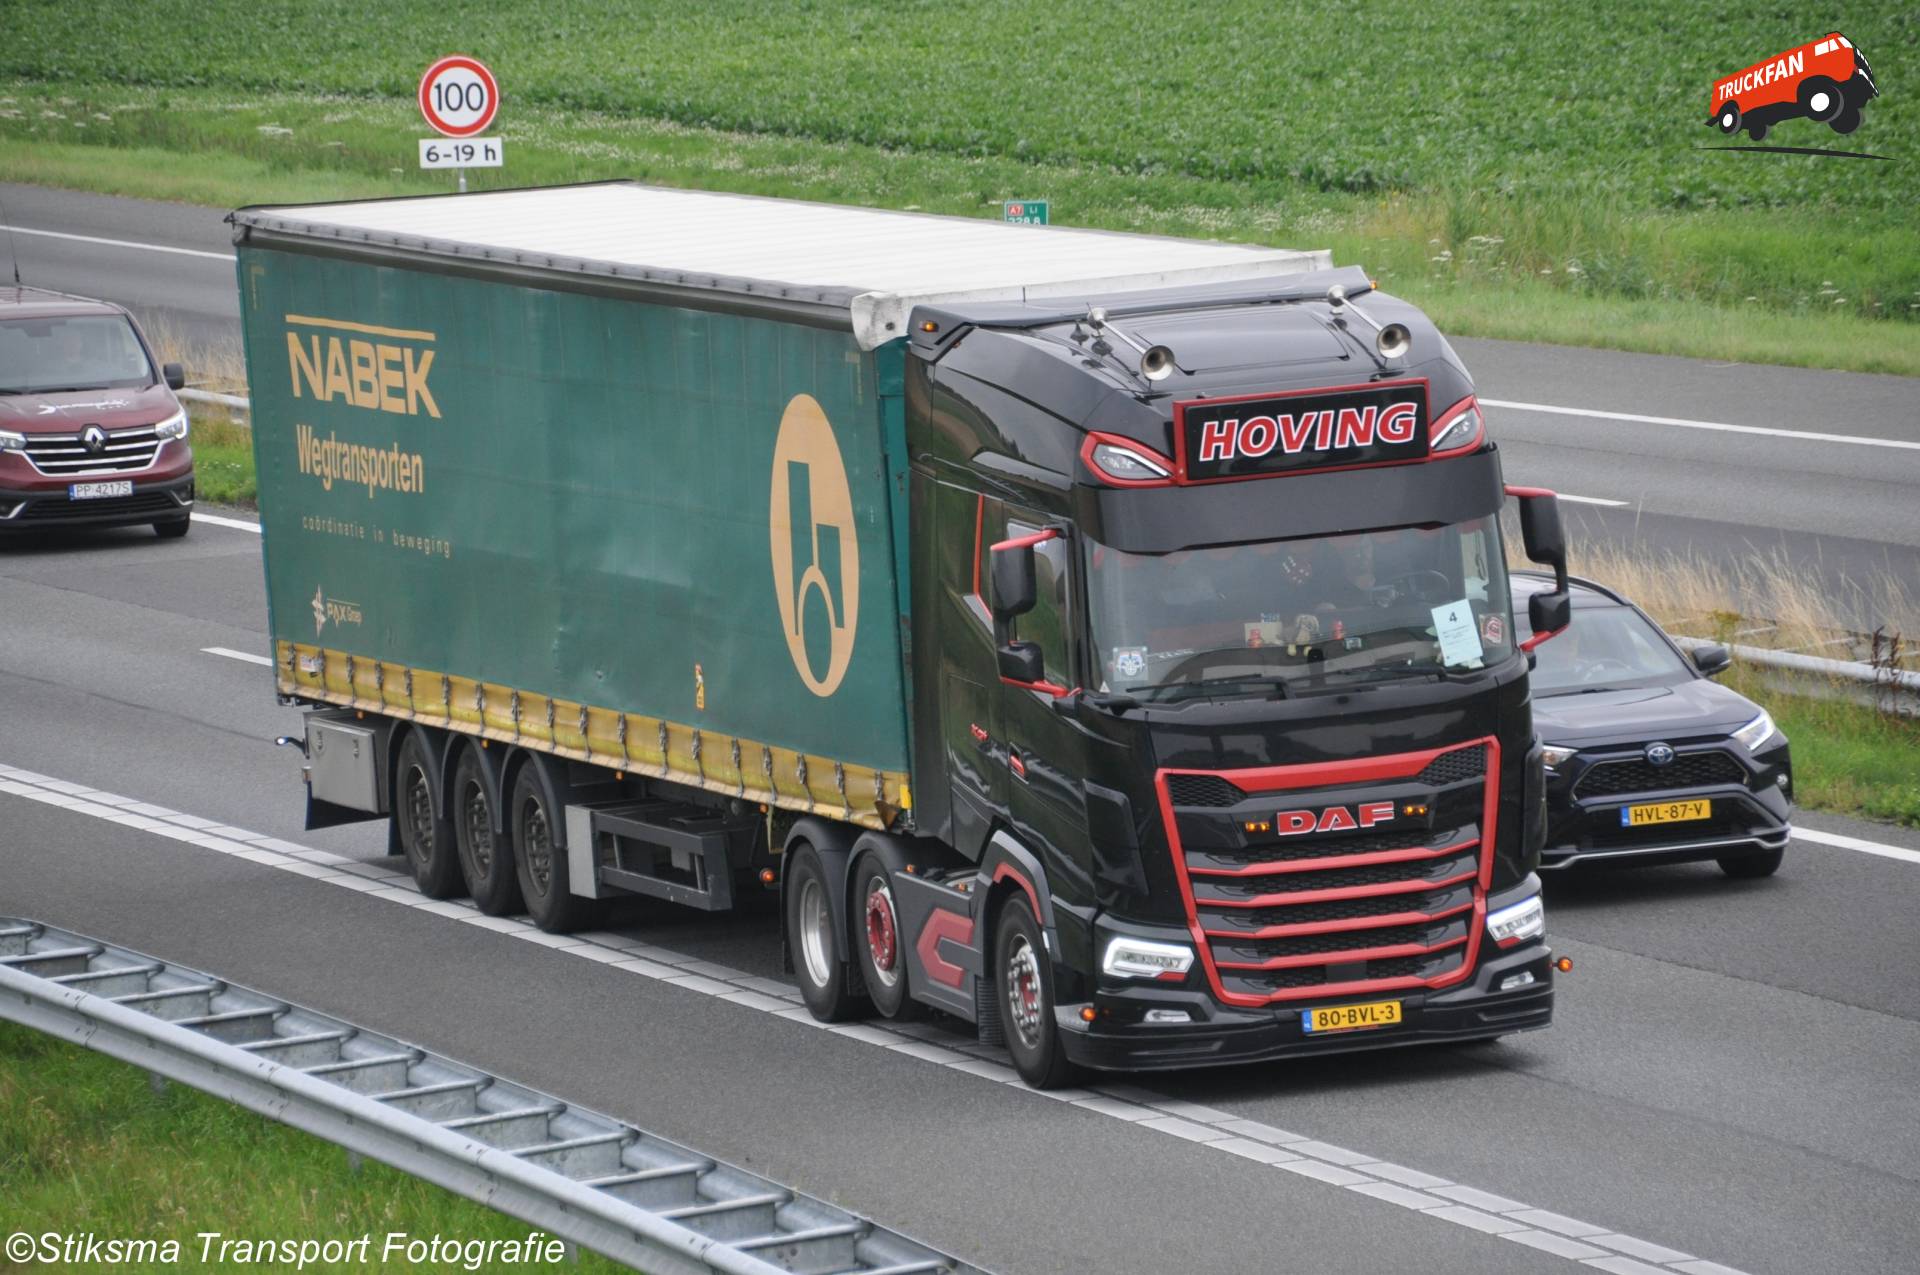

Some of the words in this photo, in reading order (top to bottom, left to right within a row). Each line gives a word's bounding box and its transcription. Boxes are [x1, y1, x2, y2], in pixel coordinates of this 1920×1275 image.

[434, 82, 484, 112] 100
[426, 144, 475, 162] 6-19
[484, 143, 497, 161] h
[286, 332, 442, 418] NABEK
[1199, 402, 1418, 462] HOVING
[296, 424, 424, 499] Wegtransporten
[373, 525, 384, 543] in
[392, 528, 450, 559] beweging
[1449, 611, 1458, 623] 4
[1276, 801, 1395, 836] DAF
[1633, 802, 1704, 823] HVL-87-V
[1318, 1004, 1395, 1027] 80-BVL-3
